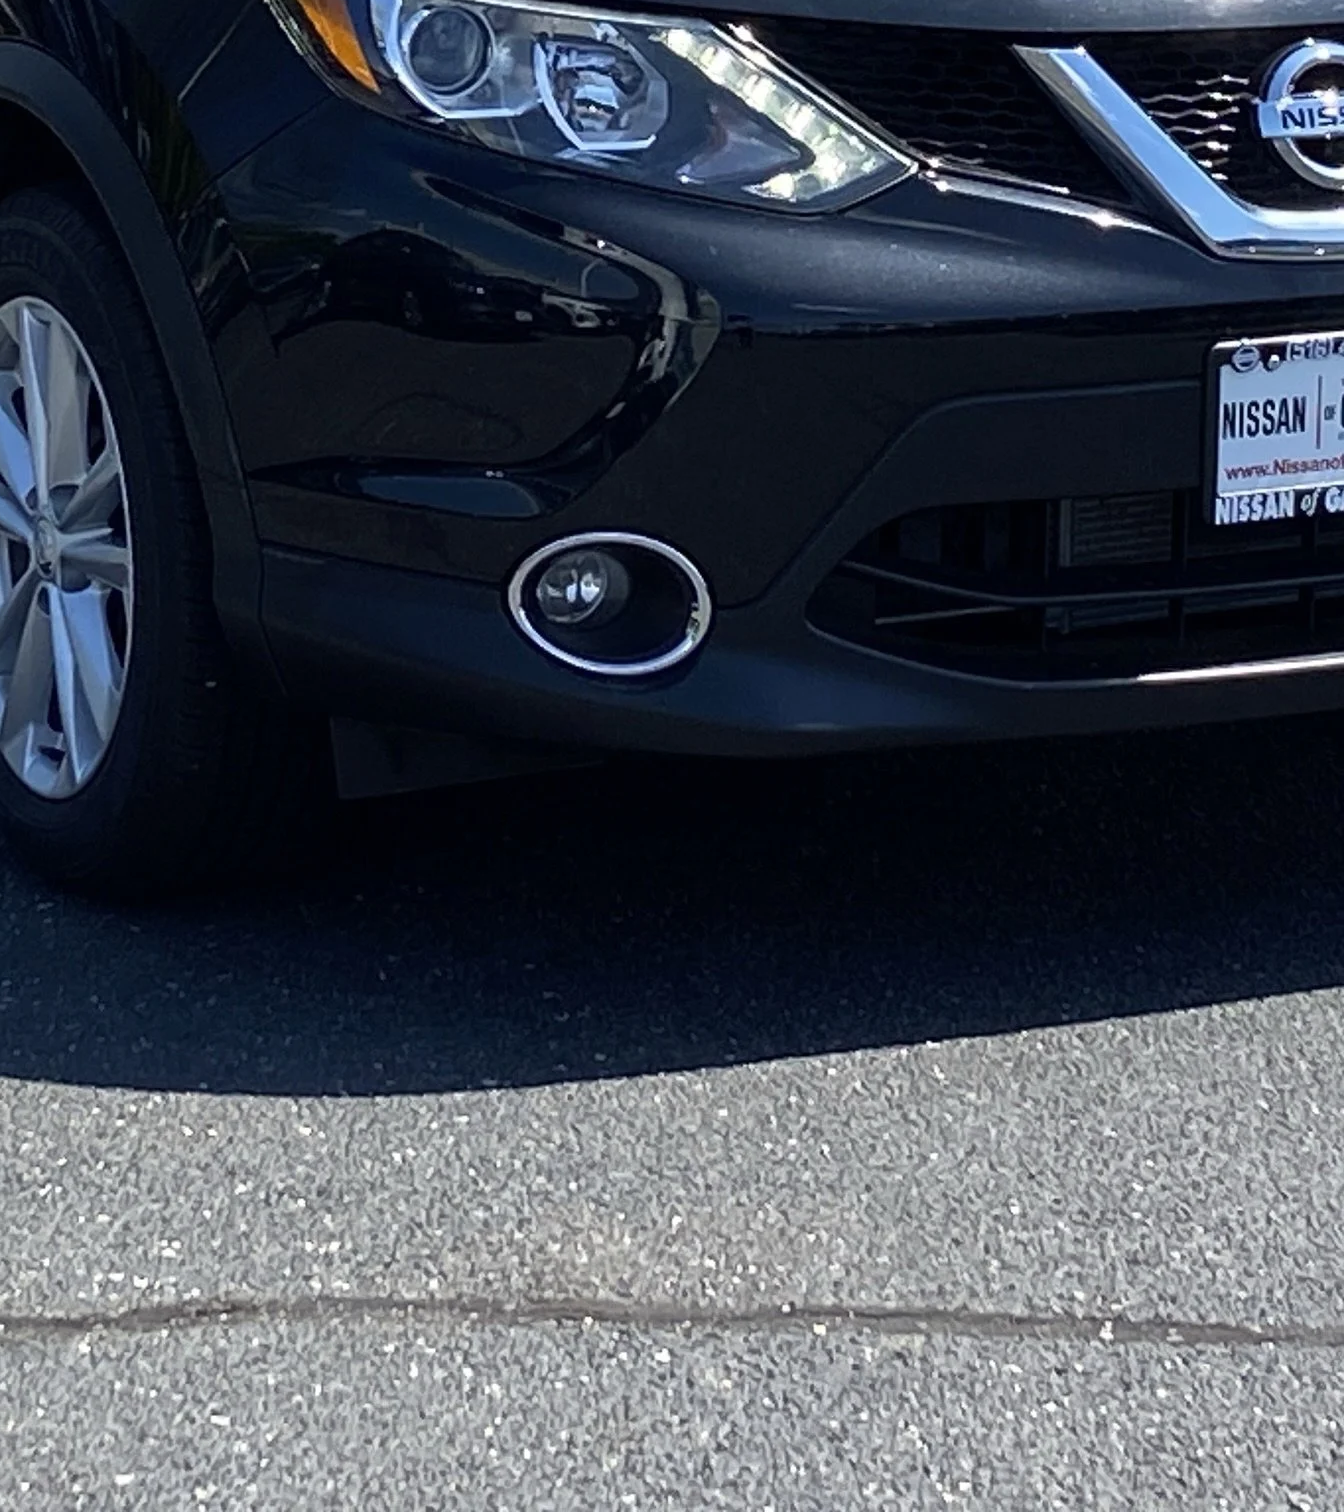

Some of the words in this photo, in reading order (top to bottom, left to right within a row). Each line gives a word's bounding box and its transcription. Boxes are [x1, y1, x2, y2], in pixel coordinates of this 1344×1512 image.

[1222, 396, 1306, 439] NISSAN
[1324, 405, 1336, 420] OF
[1215, 490, 1294, 525] NISSAN
[1300, 487, 1320, 516] of
